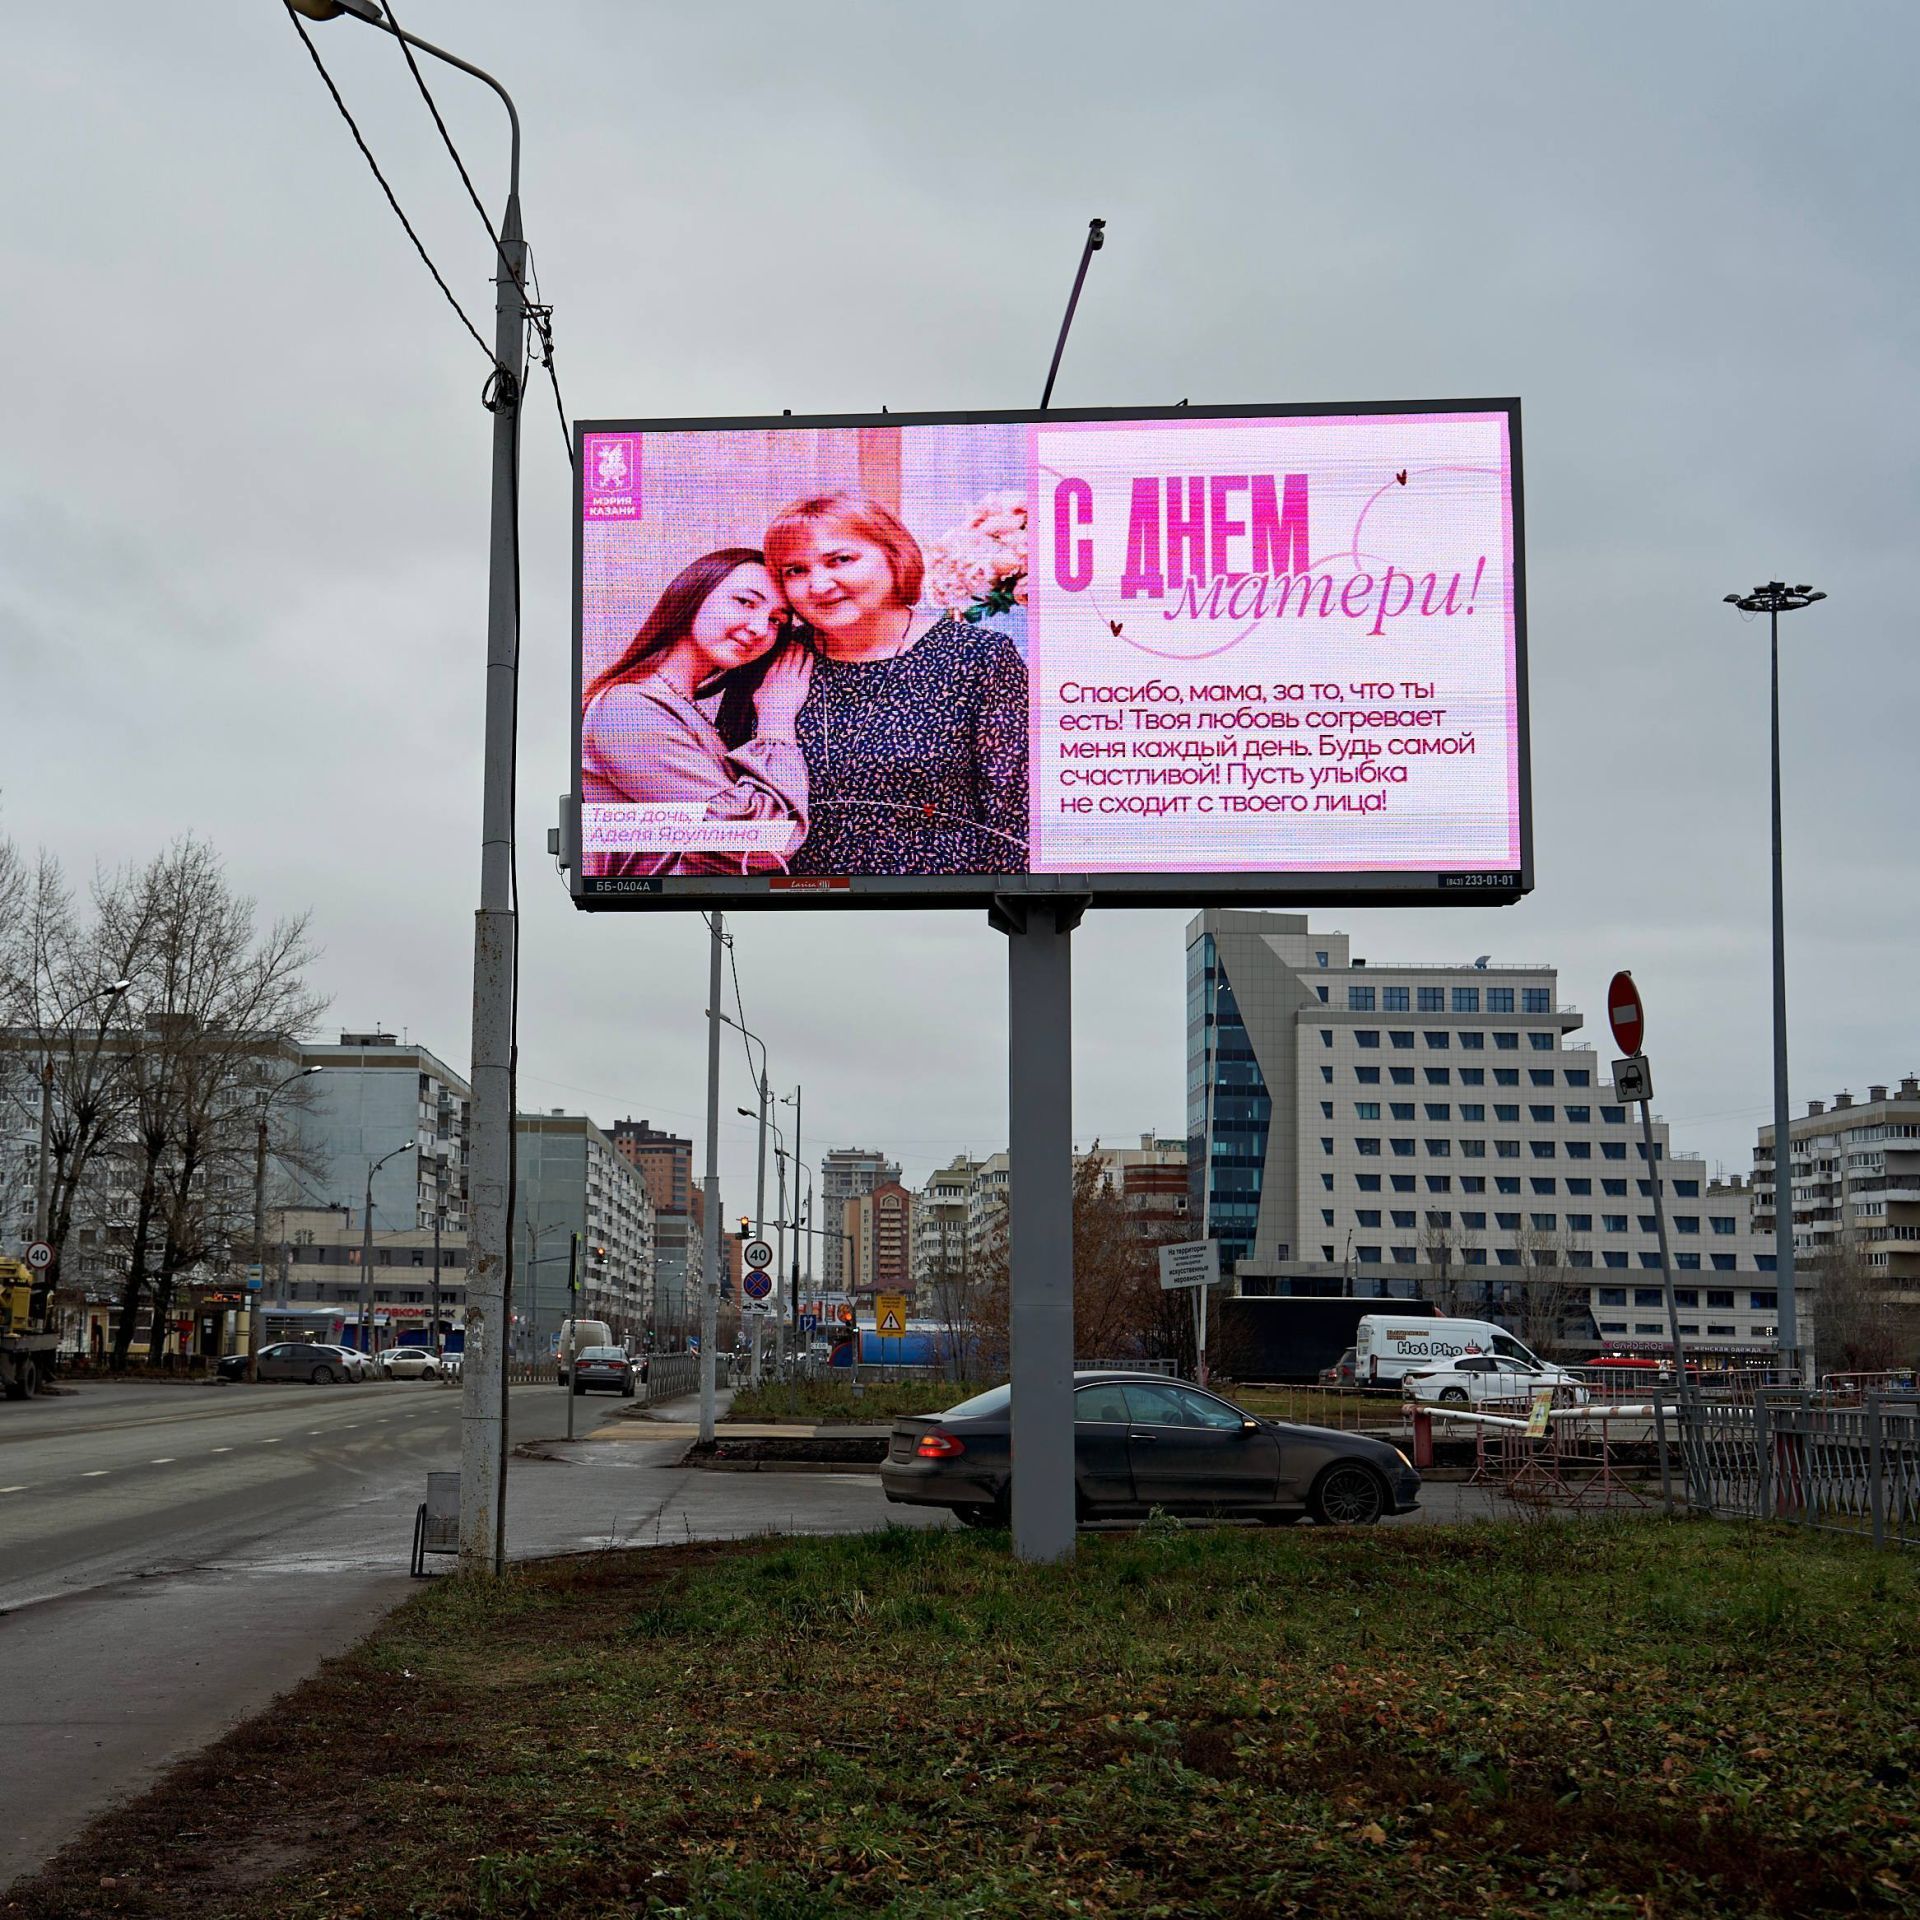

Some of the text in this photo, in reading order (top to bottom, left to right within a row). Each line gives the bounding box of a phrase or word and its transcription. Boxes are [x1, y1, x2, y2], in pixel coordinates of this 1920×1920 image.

[593, 497, 632, 505] МЭРИЯ
[589, 506, 636, 515] КАЗАНИ
[1054, 473, 1309, 599] С ДНЕМ
[1164, 555, 1486, 636] матери!
[1060, 680, 1435, 704] Спасибо, мама, за то, что ты
[1060, 706, 1446, 733] есть! Твоя любовь согревает
[1060, 732, 1475, 762] меня каждый день. Будь самой
[1060, 760, 1408, 790] счастливой! Пусть улыбка
[1061, 790, 1387, 816] не сходит с твоего лица!
[592, 807, 636, 822] Твоя
[658, 826, 760, 842] Яруллина
[596, 881, 650, 891] ББ-0404А
[1465, 875, 1513, 885] 233-01-01
[32, 1250, 48, 1261] 40
[750, 1250, 767, 1260] 40
[375, 1307, 456, 1318] СОВКОМБНК
[1397, 1341, 1463, 1356] Hot Pho
